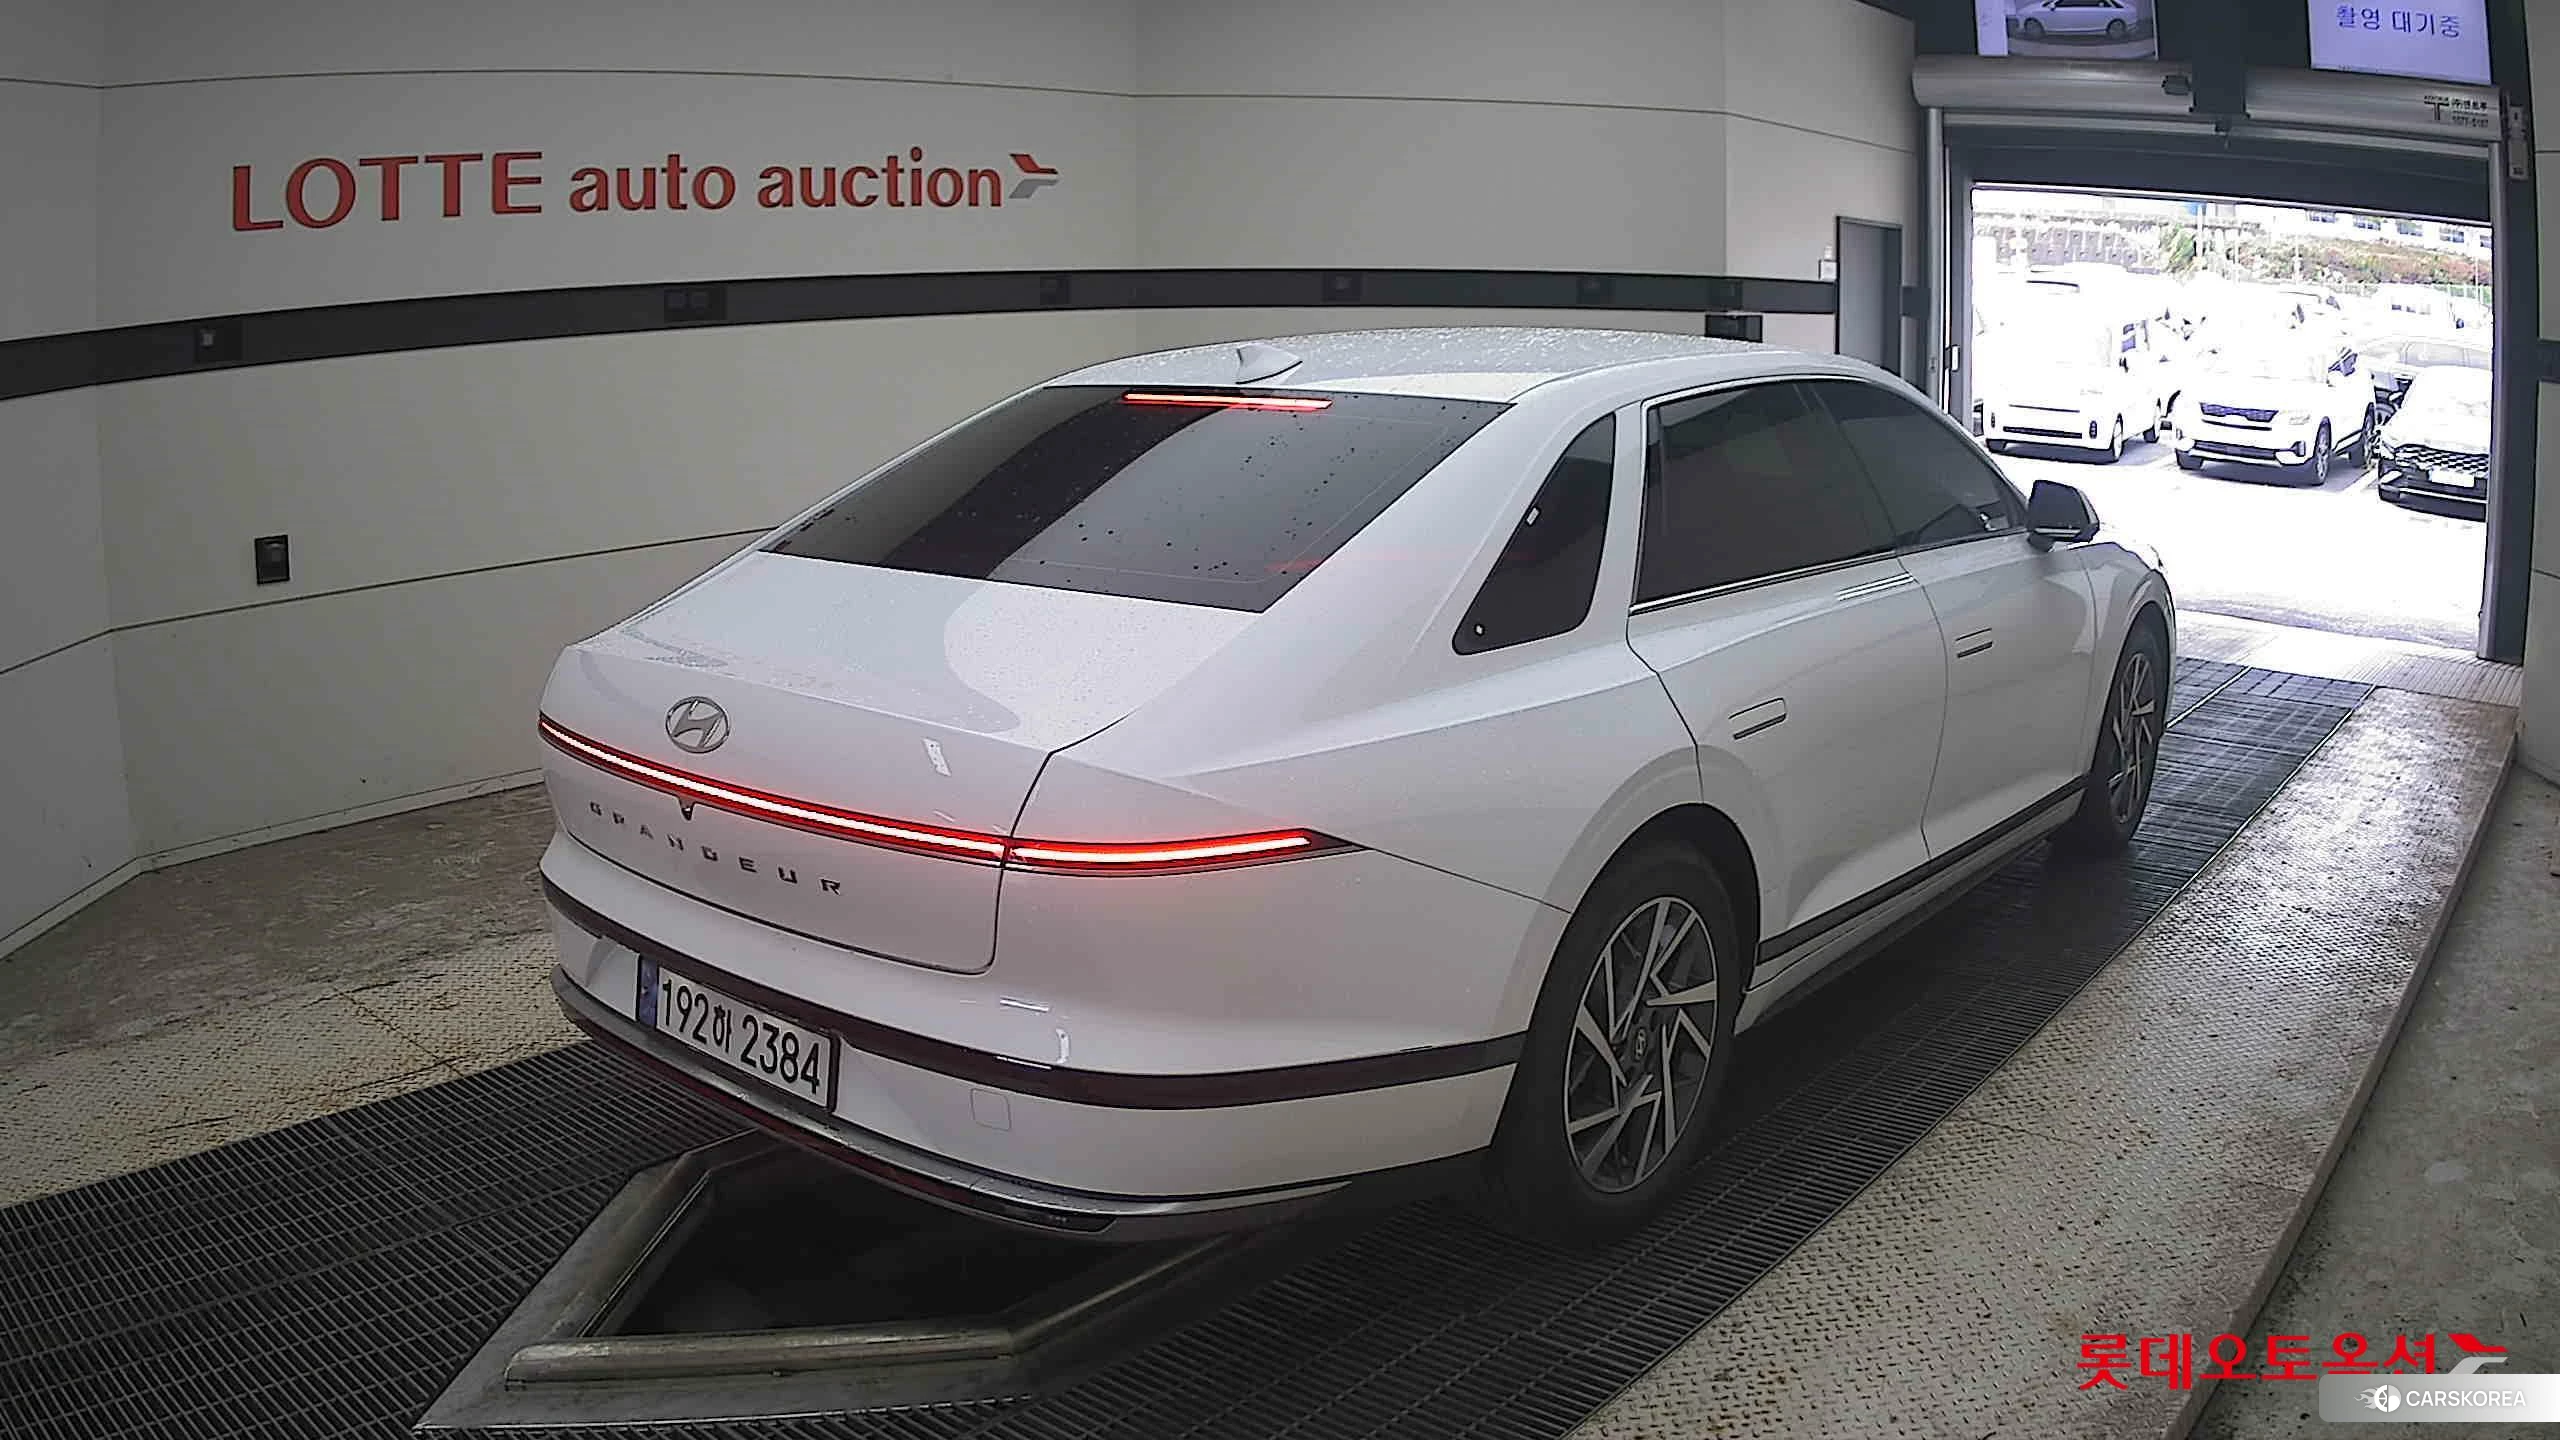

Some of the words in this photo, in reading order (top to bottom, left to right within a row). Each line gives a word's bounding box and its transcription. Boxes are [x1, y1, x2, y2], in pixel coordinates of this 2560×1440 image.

[2337, 5, 2381, 30] 촬영
[2392, 10, 2460, 38] 대기중
[232, 151, 543, 231] LOTTE
[568, 152, 737, 212] auto
[757, 146, 1003, 210] auction
[589, 801, 841, 895] GRANDEUR
[662, 979, 732, 1053] 192하
[740, 1014, 820, 1095] 2384
